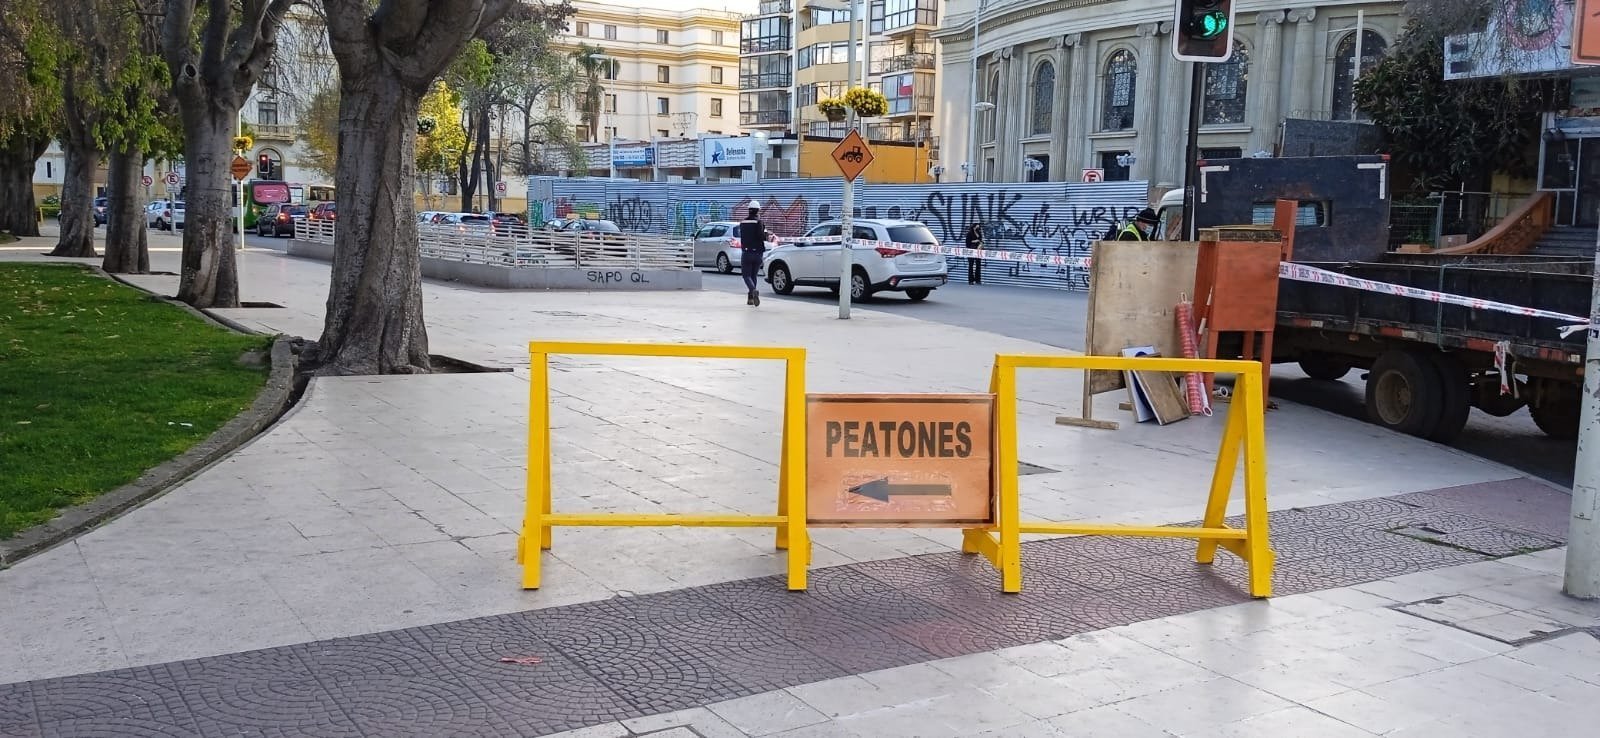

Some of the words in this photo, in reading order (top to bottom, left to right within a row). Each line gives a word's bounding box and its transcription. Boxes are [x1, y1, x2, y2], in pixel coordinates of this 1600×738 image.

[587, 271, 622, 284] SAPO
[631, 272, 649, 283] QL
[826, 421, 972, 458] PEATONES
